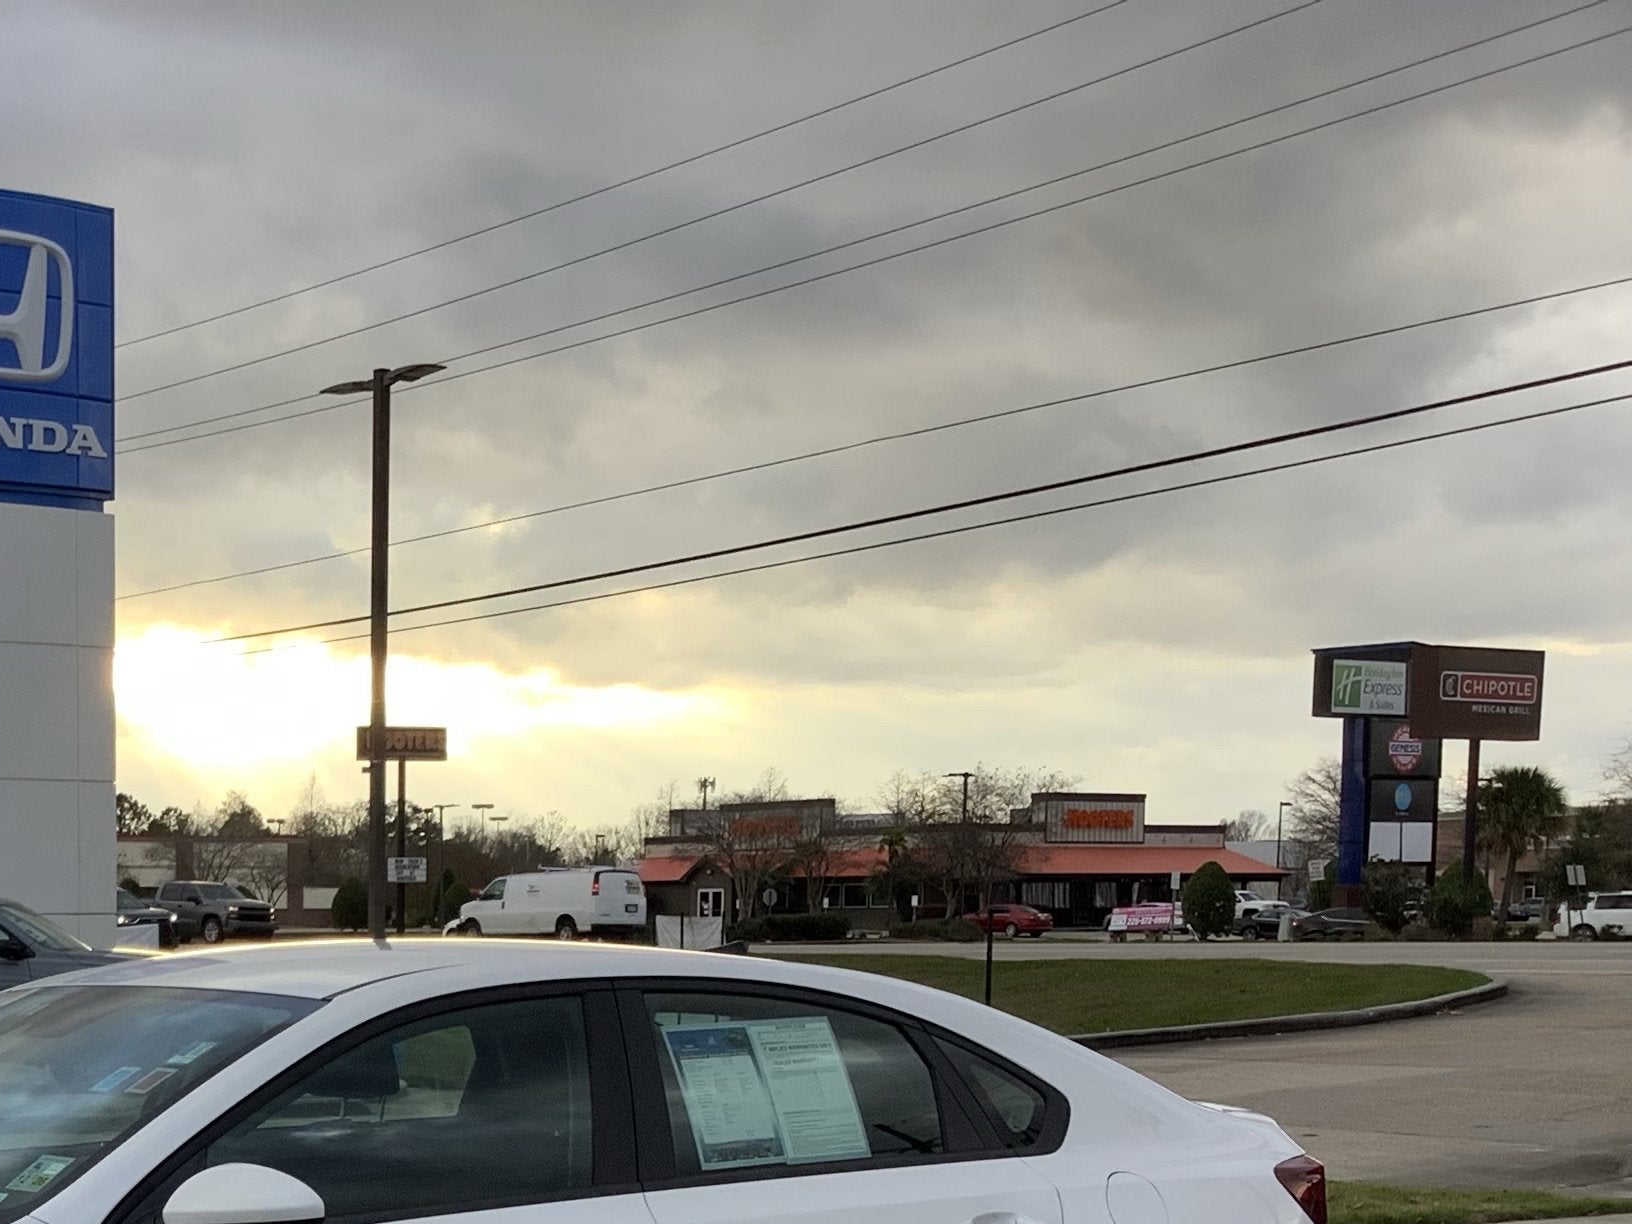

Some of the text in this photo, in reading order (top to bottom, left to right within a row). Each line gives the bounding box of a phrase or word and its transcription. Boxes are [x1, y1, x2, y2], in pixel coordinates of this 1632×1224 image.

[1363, 679, 1403, 697] Express
[1462, 679, 1532, 697] CHIPOTLE
[1471, 704, 1530, 716] MEXICAN GRILL
